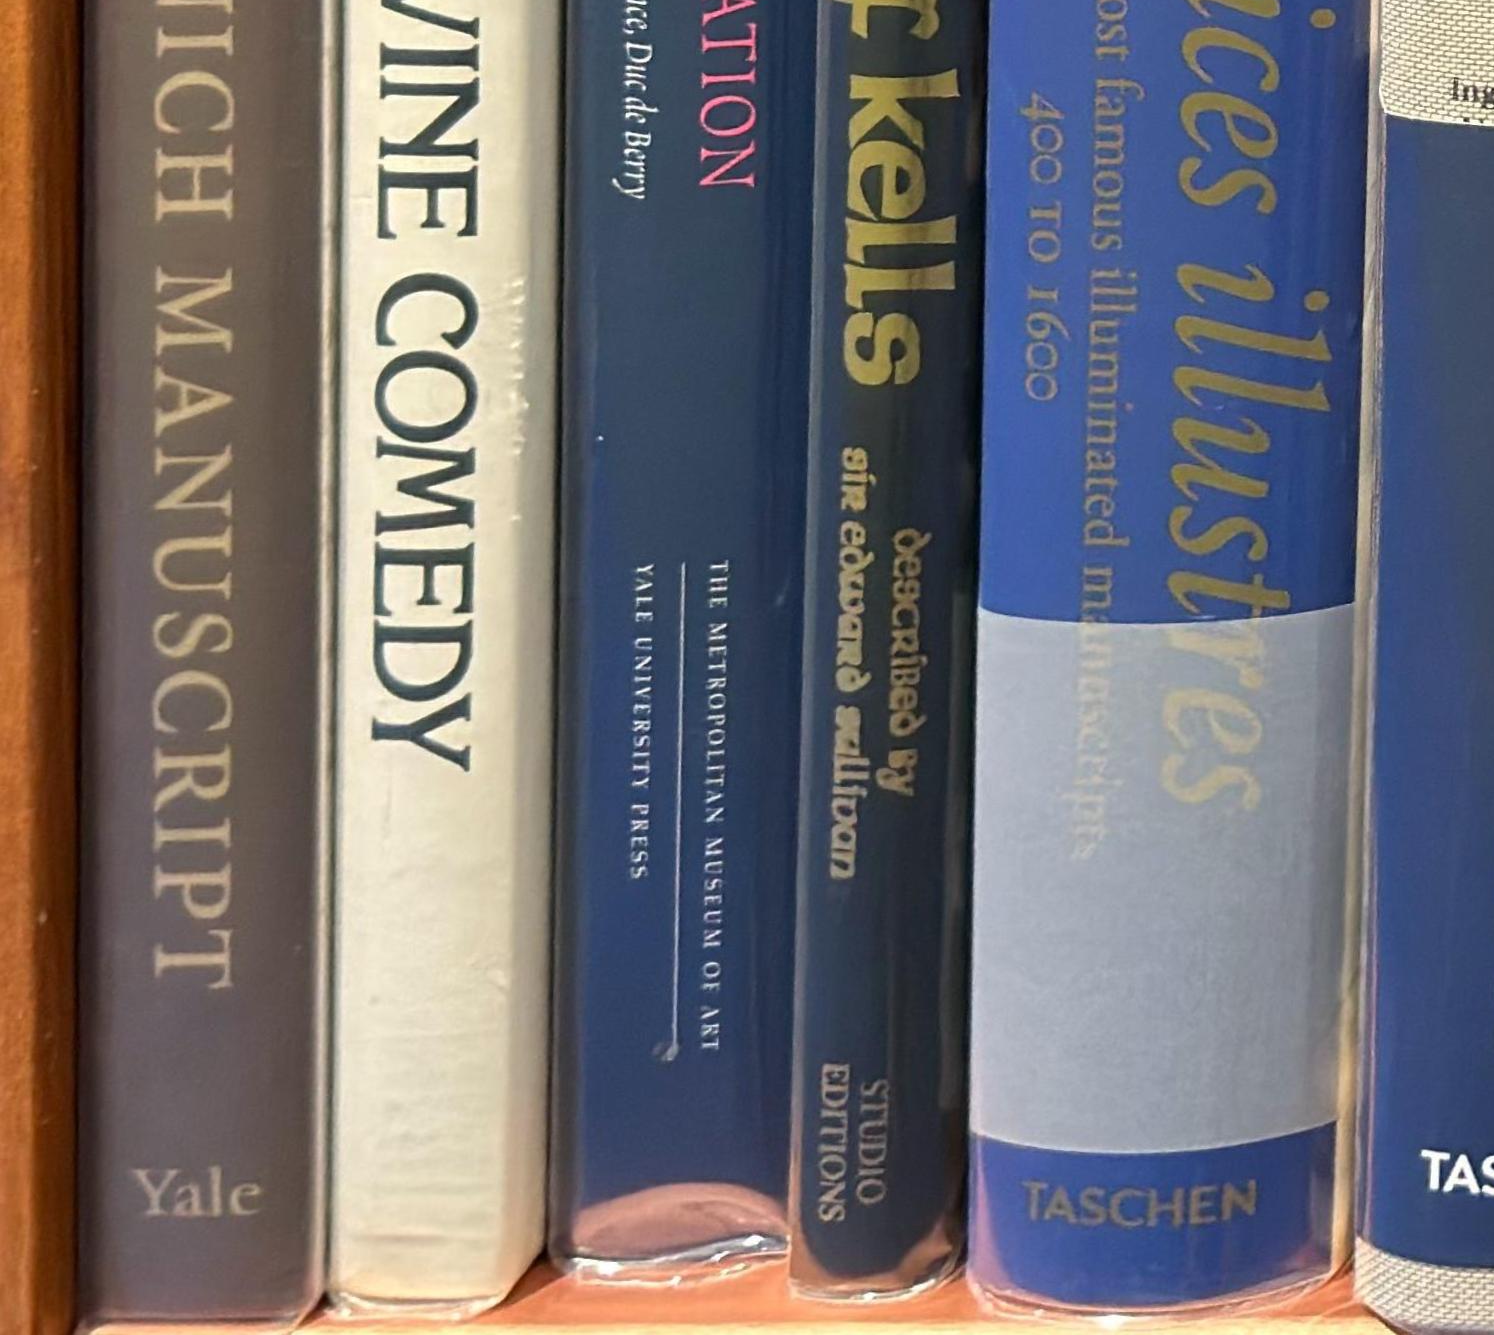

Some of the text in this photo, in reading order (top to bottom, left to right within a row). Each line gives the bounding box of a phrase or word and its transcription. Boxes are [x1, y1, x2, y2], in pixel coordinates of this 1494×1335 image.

[624, 42, 652, 91] Duc
[625, 97, 659, 123] de
[612, 131, 651, 199] Berry
[1020, 93, 1064, 184] 400
[1091, 77, 1144, 250] famous
[1029, 202, 1061, 263] TO
[1082, 268, 1137, 547] illuminated
[371, 273, 478, 771] COMEDY
[1161, 262, 1334, 812] illustres
[152, 266, 233, 989] MANUSCRIPT
[630, 564, 653, 878] YALE UNIVERSITY PRESS
[701, 560, 728, 1049] THE METROPOLITAN MUSEUM OF ART
[132, 1166, 261, 1217] Yale
[818, 1064, 849, 1221] EDITIONS
[856, 1080, 890, 1205] STUDIO
[1025, 1180, 1256, 1228] TASCHEN
